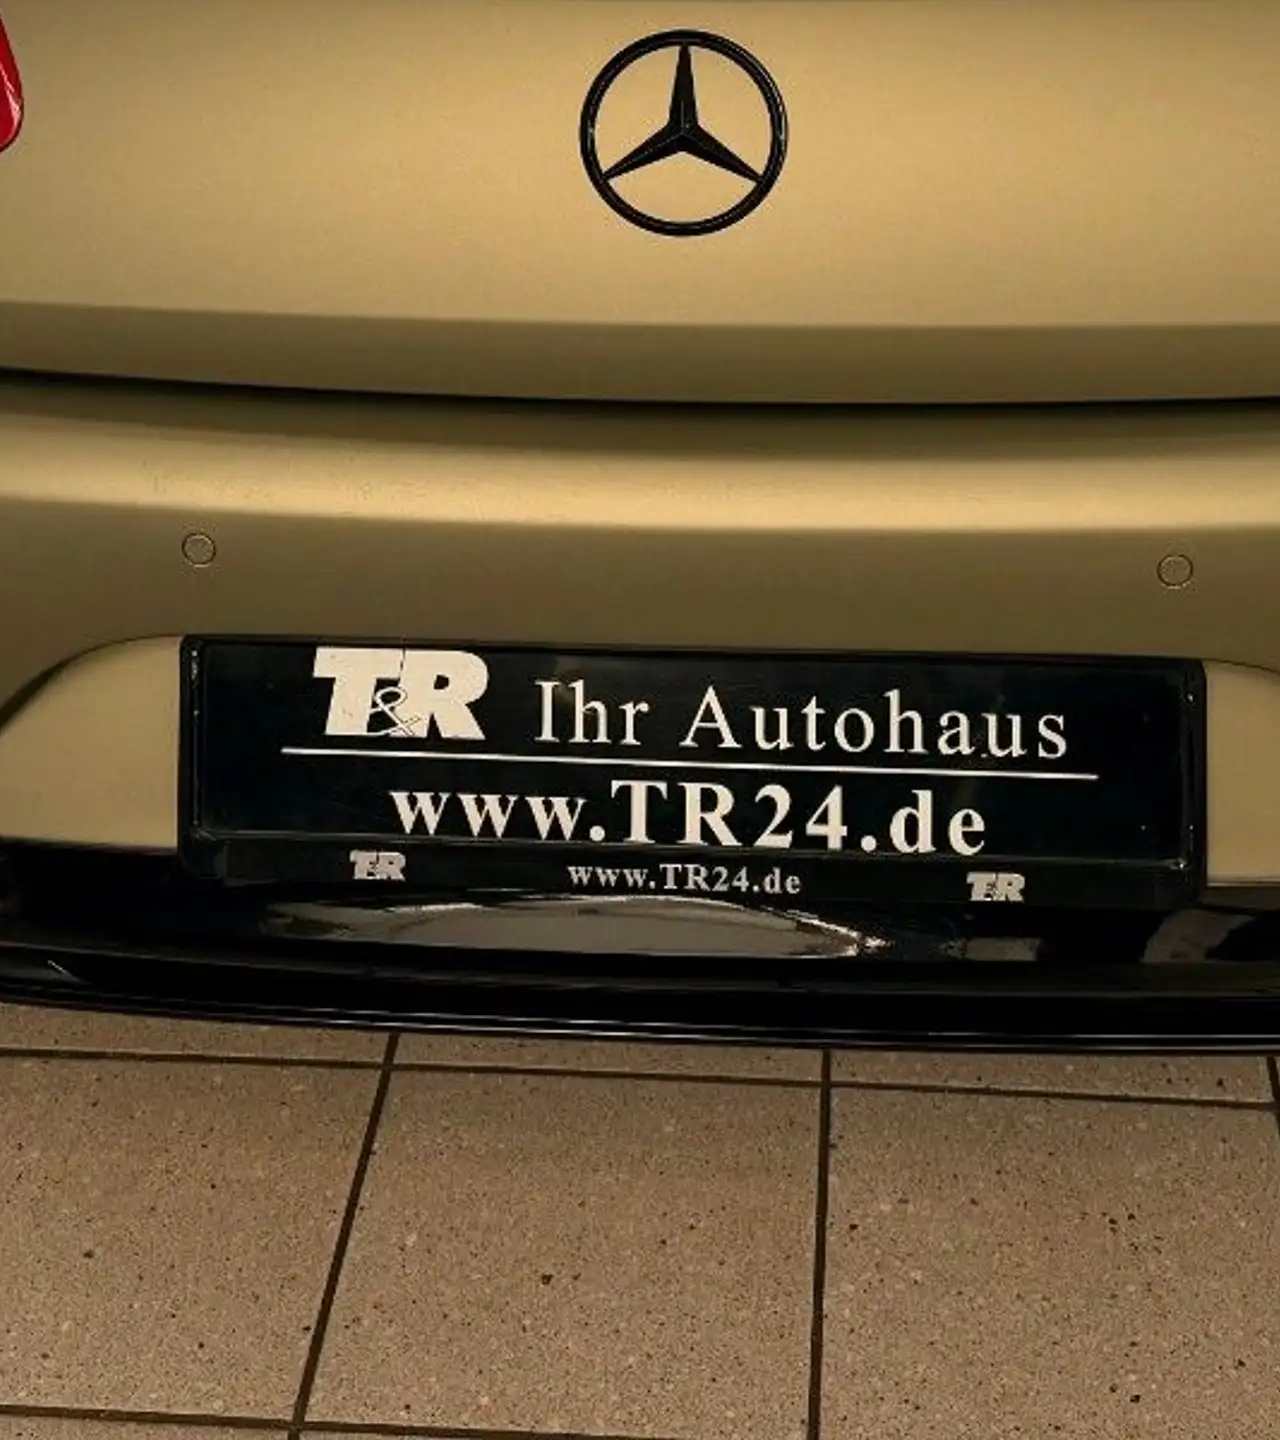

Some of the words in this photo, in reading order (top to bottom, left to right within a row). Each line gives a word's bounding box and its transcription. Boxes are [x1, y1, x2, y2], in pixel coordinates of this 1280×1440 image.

[534, 679, 650, 746] Ihr
[679, 685, 1067, 759] Autohaus
[389, 779, 986, 856] www.TR24.de
[567, 863, 801, 894] www.TR24.de
